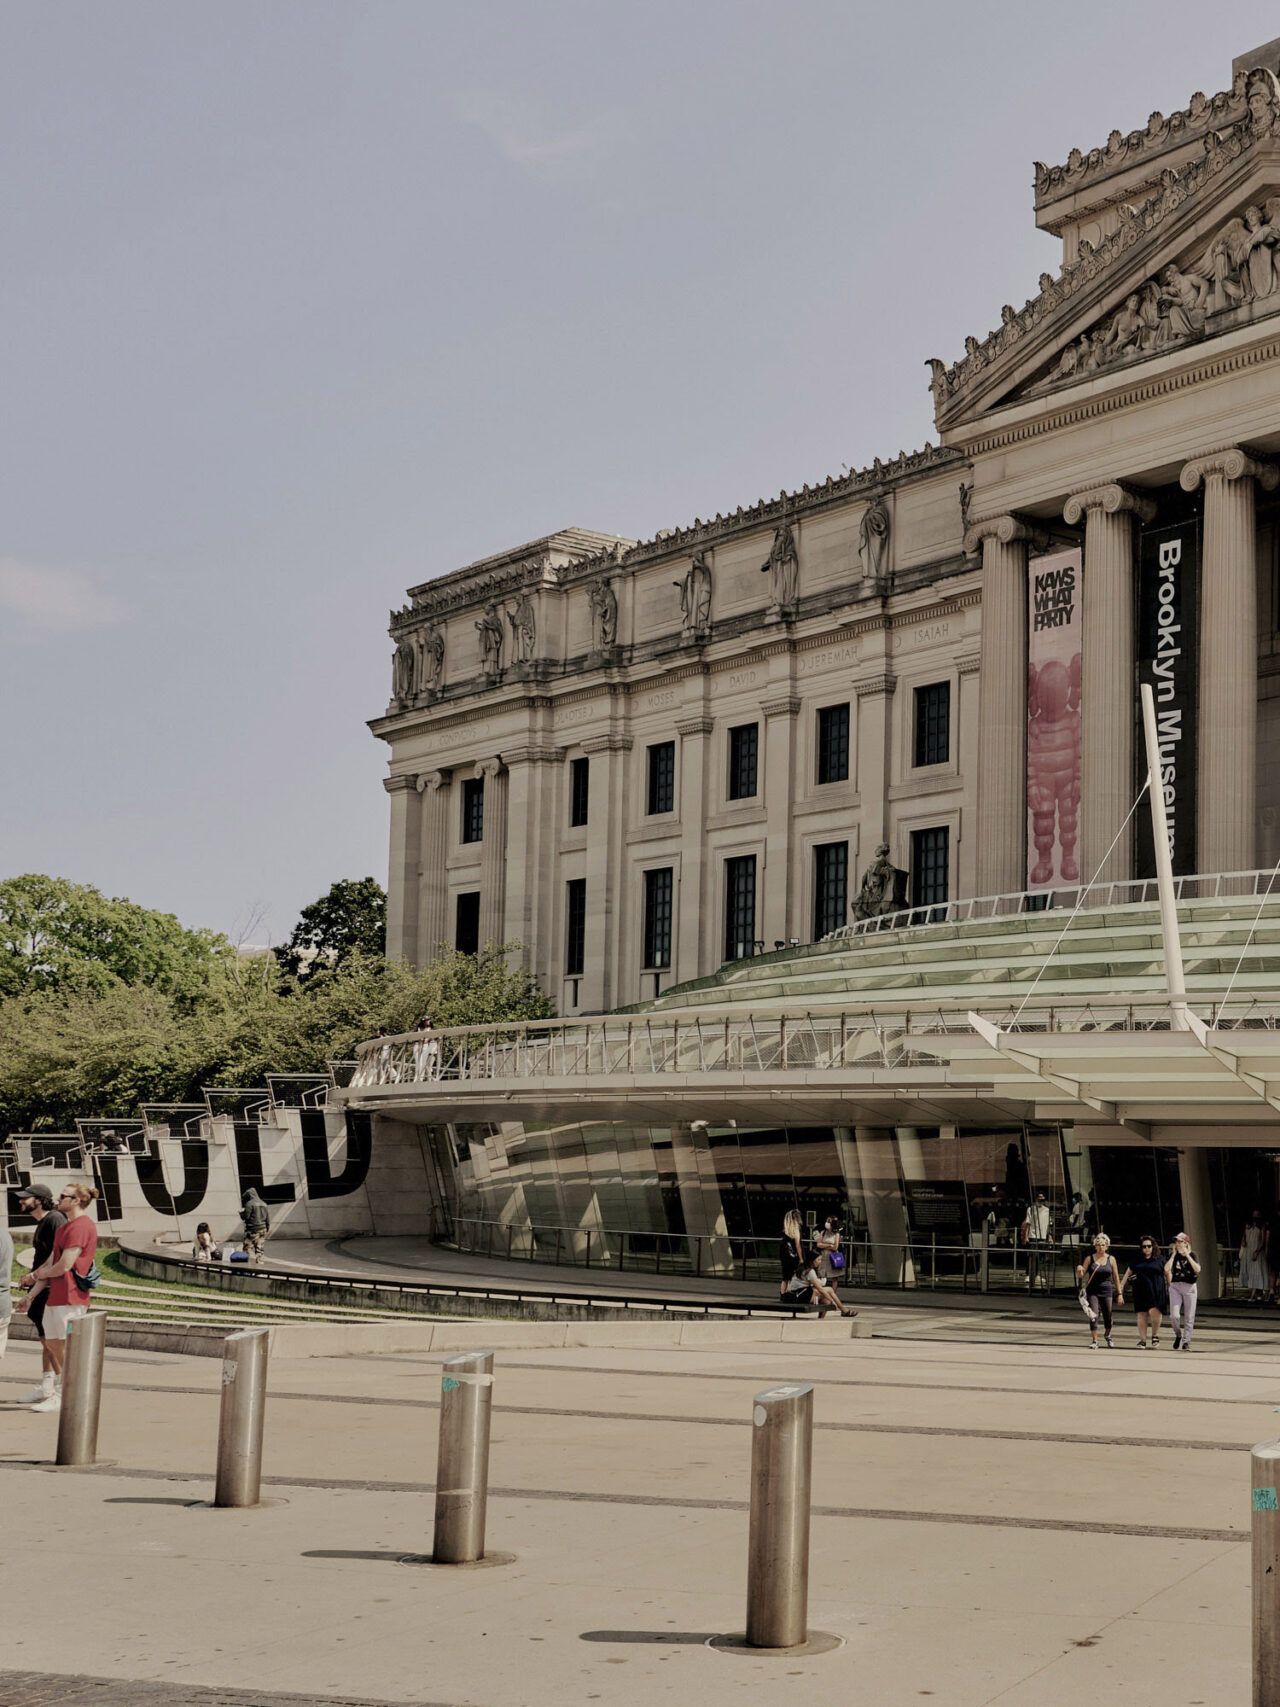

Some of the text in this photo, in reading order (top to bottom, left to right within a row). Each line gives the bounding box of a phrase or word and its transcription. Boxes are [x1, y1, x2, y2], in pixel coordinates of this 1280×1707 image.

[1035, 566, 1075, 593] KAWS
[1034, 585, 1075, 612] WHAT
[1034, 604, 1075, 632] PARTY
[914, 623, 949, 646] ISAIAH
[808, 645, 858, 669] JEREMIAH
[729, 671, 757, 689] DAVID
[1152, 538, 1182, 861] Brooklyn Muse
